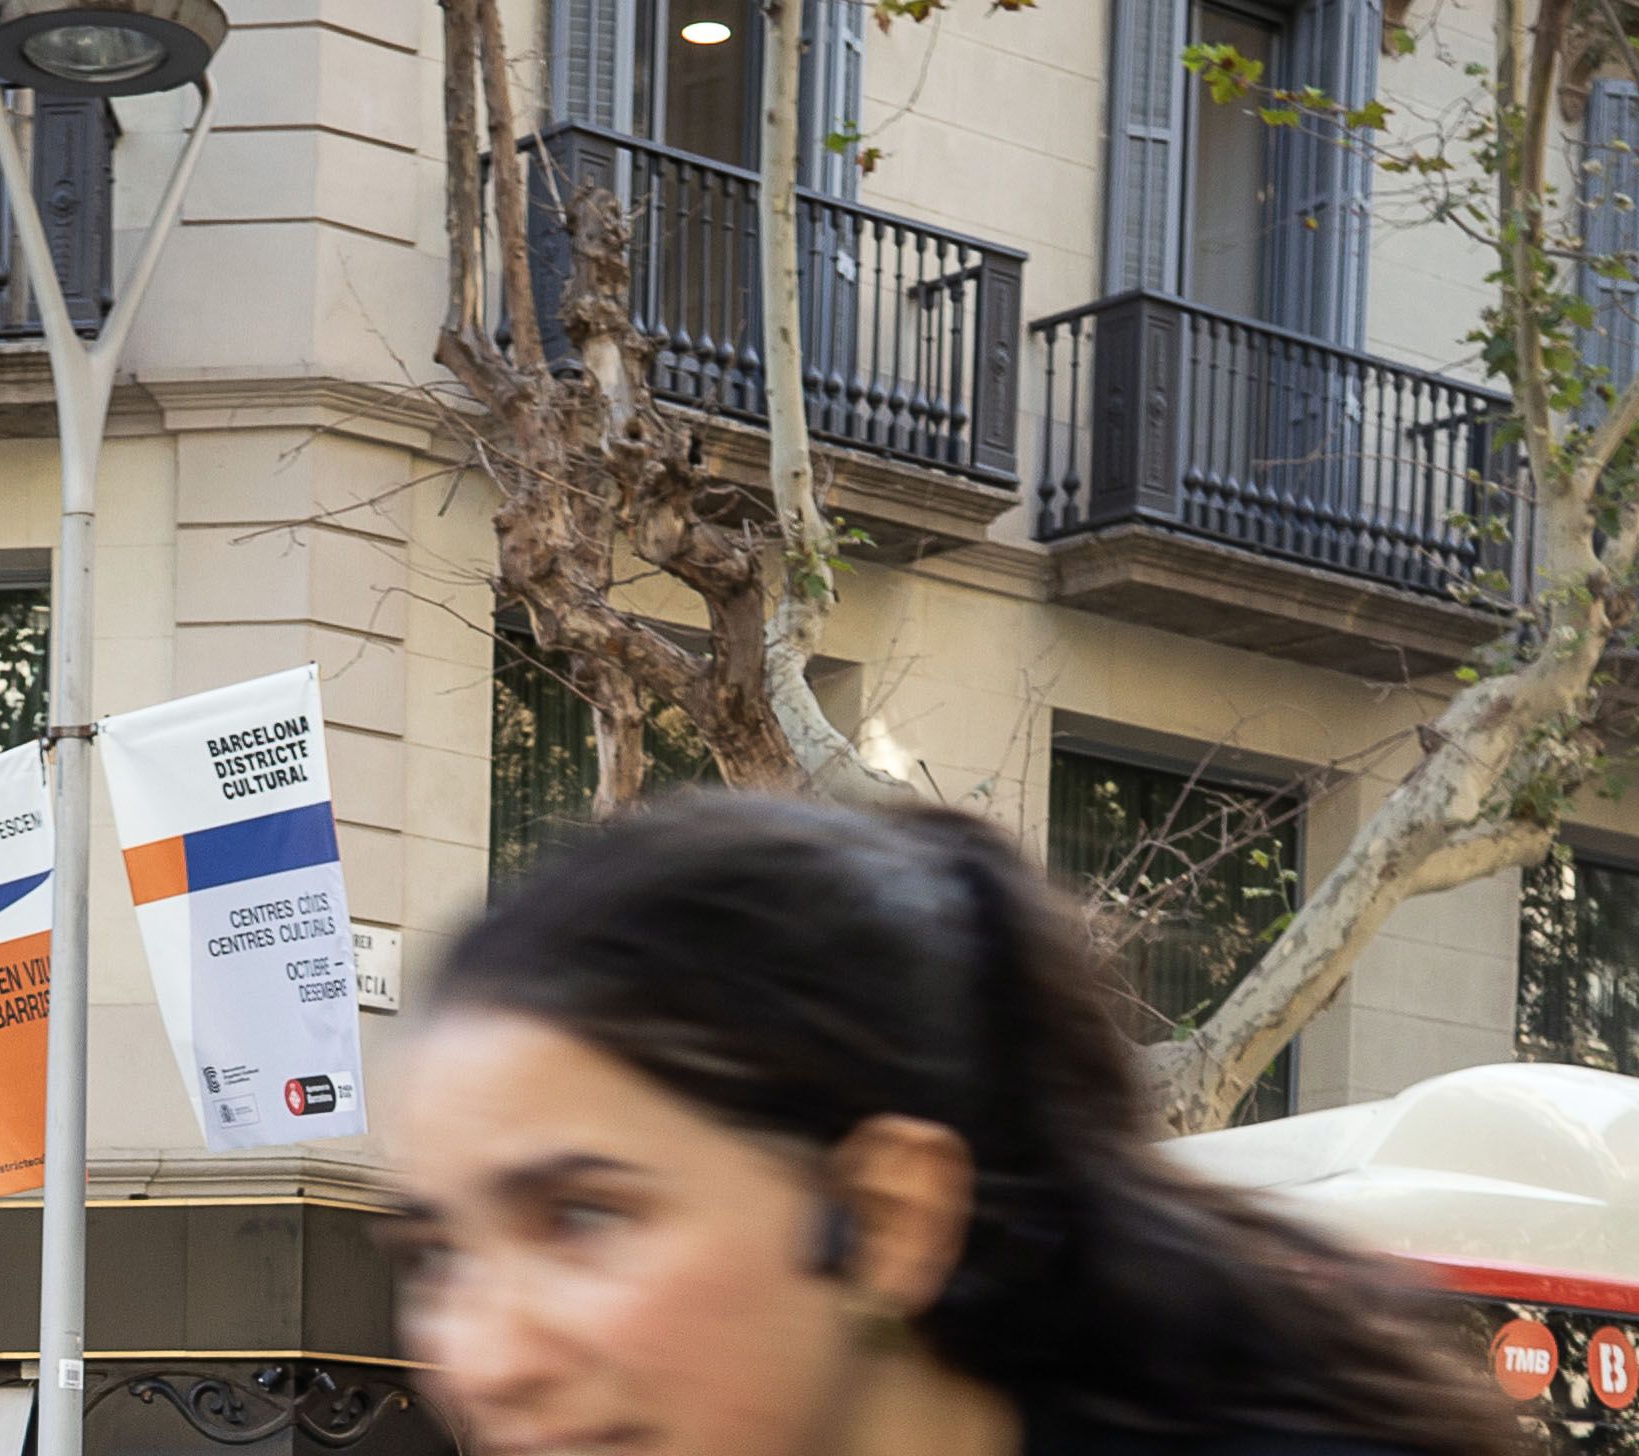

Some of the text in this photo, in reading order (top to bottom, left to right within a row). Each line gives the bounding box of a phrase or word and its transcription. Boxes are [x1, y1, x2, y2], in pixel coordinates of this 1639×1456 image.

[207, 715, 310, 758] BARCELONA
[214, 739, 308, 779] DISTRICTE
[222, 764, 308, 800] CULTURAL
[230, 900, 295, 929] CENTRES
[208, 928, 275, 957] CENTRES
[1504, 1342, 1628, 1393] TMB B
